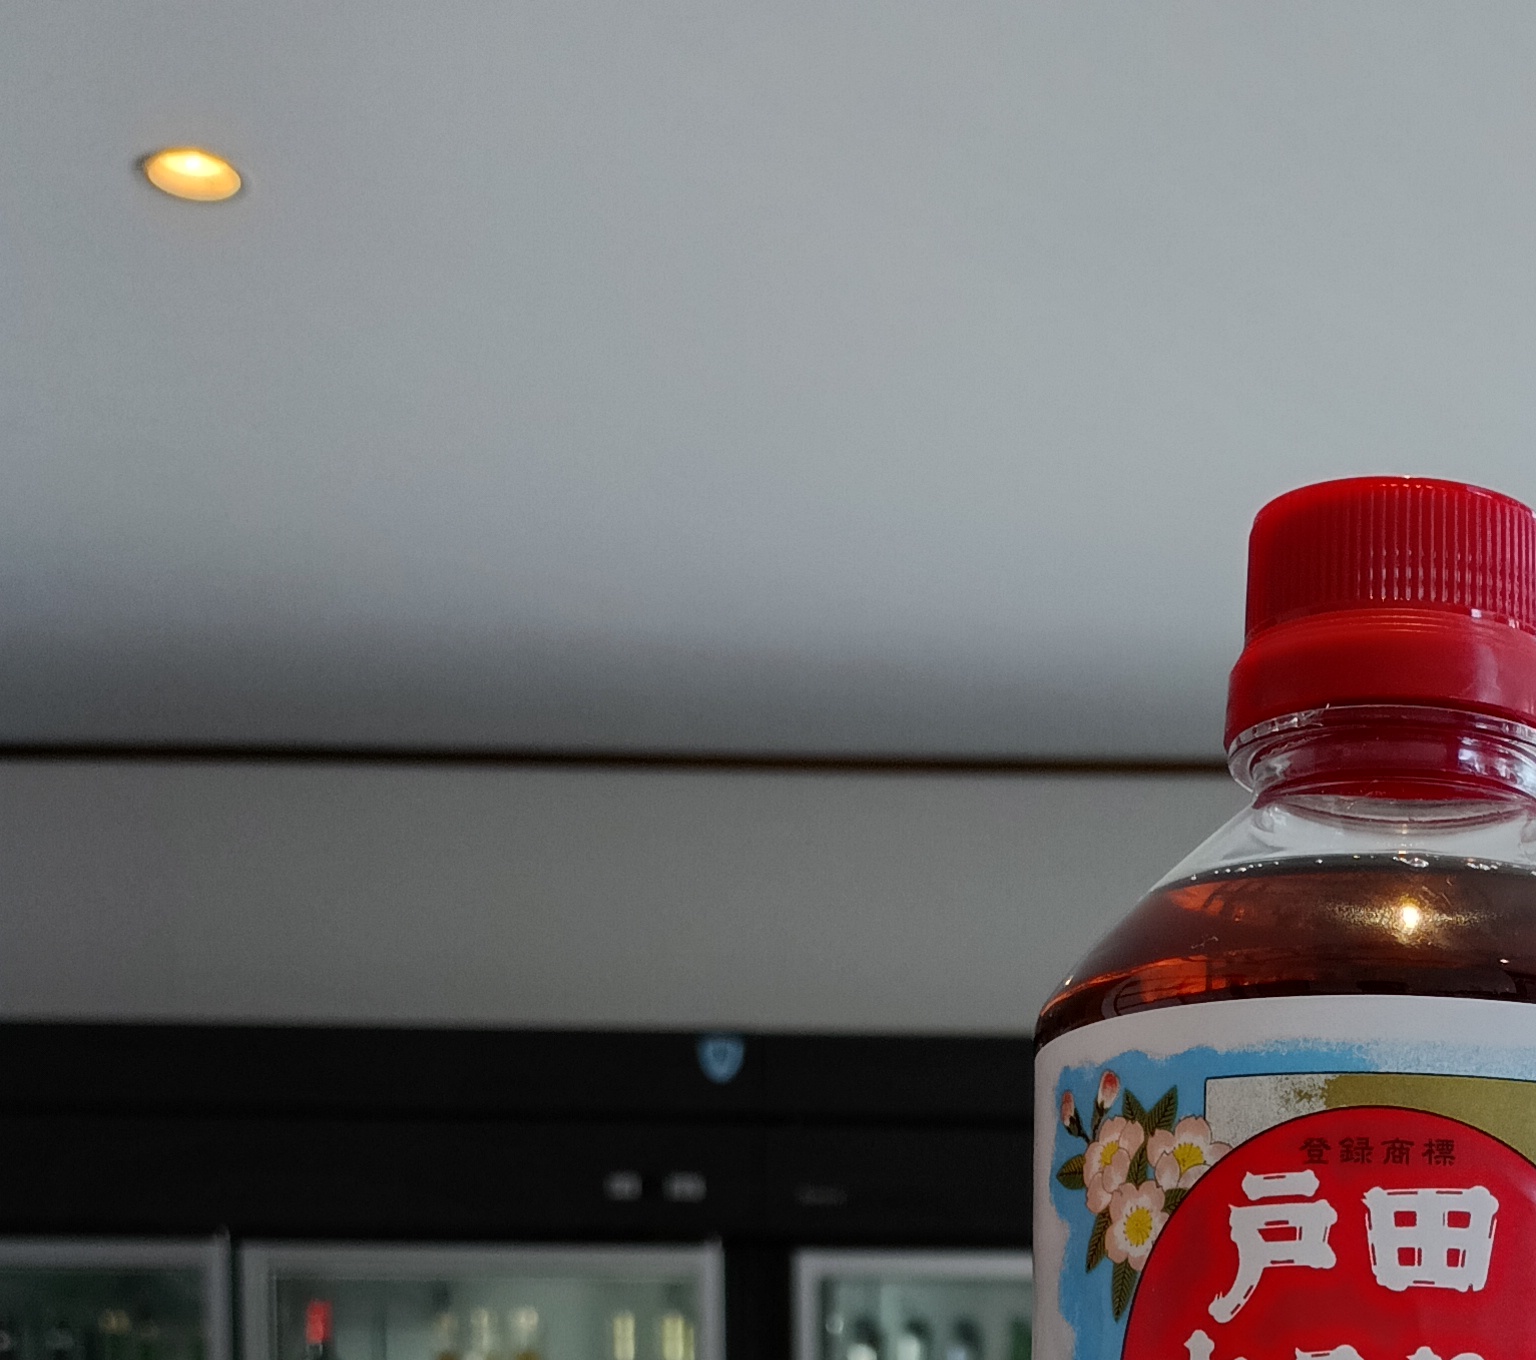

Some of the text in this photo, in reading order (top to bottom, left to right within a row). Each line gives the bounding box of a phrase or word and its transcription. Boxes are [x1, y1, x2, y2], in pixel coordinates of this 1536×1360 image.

[1300, 1137, 1456, 1166] 登録商標
[1208, 1169, 1500, 1324] 戸田
